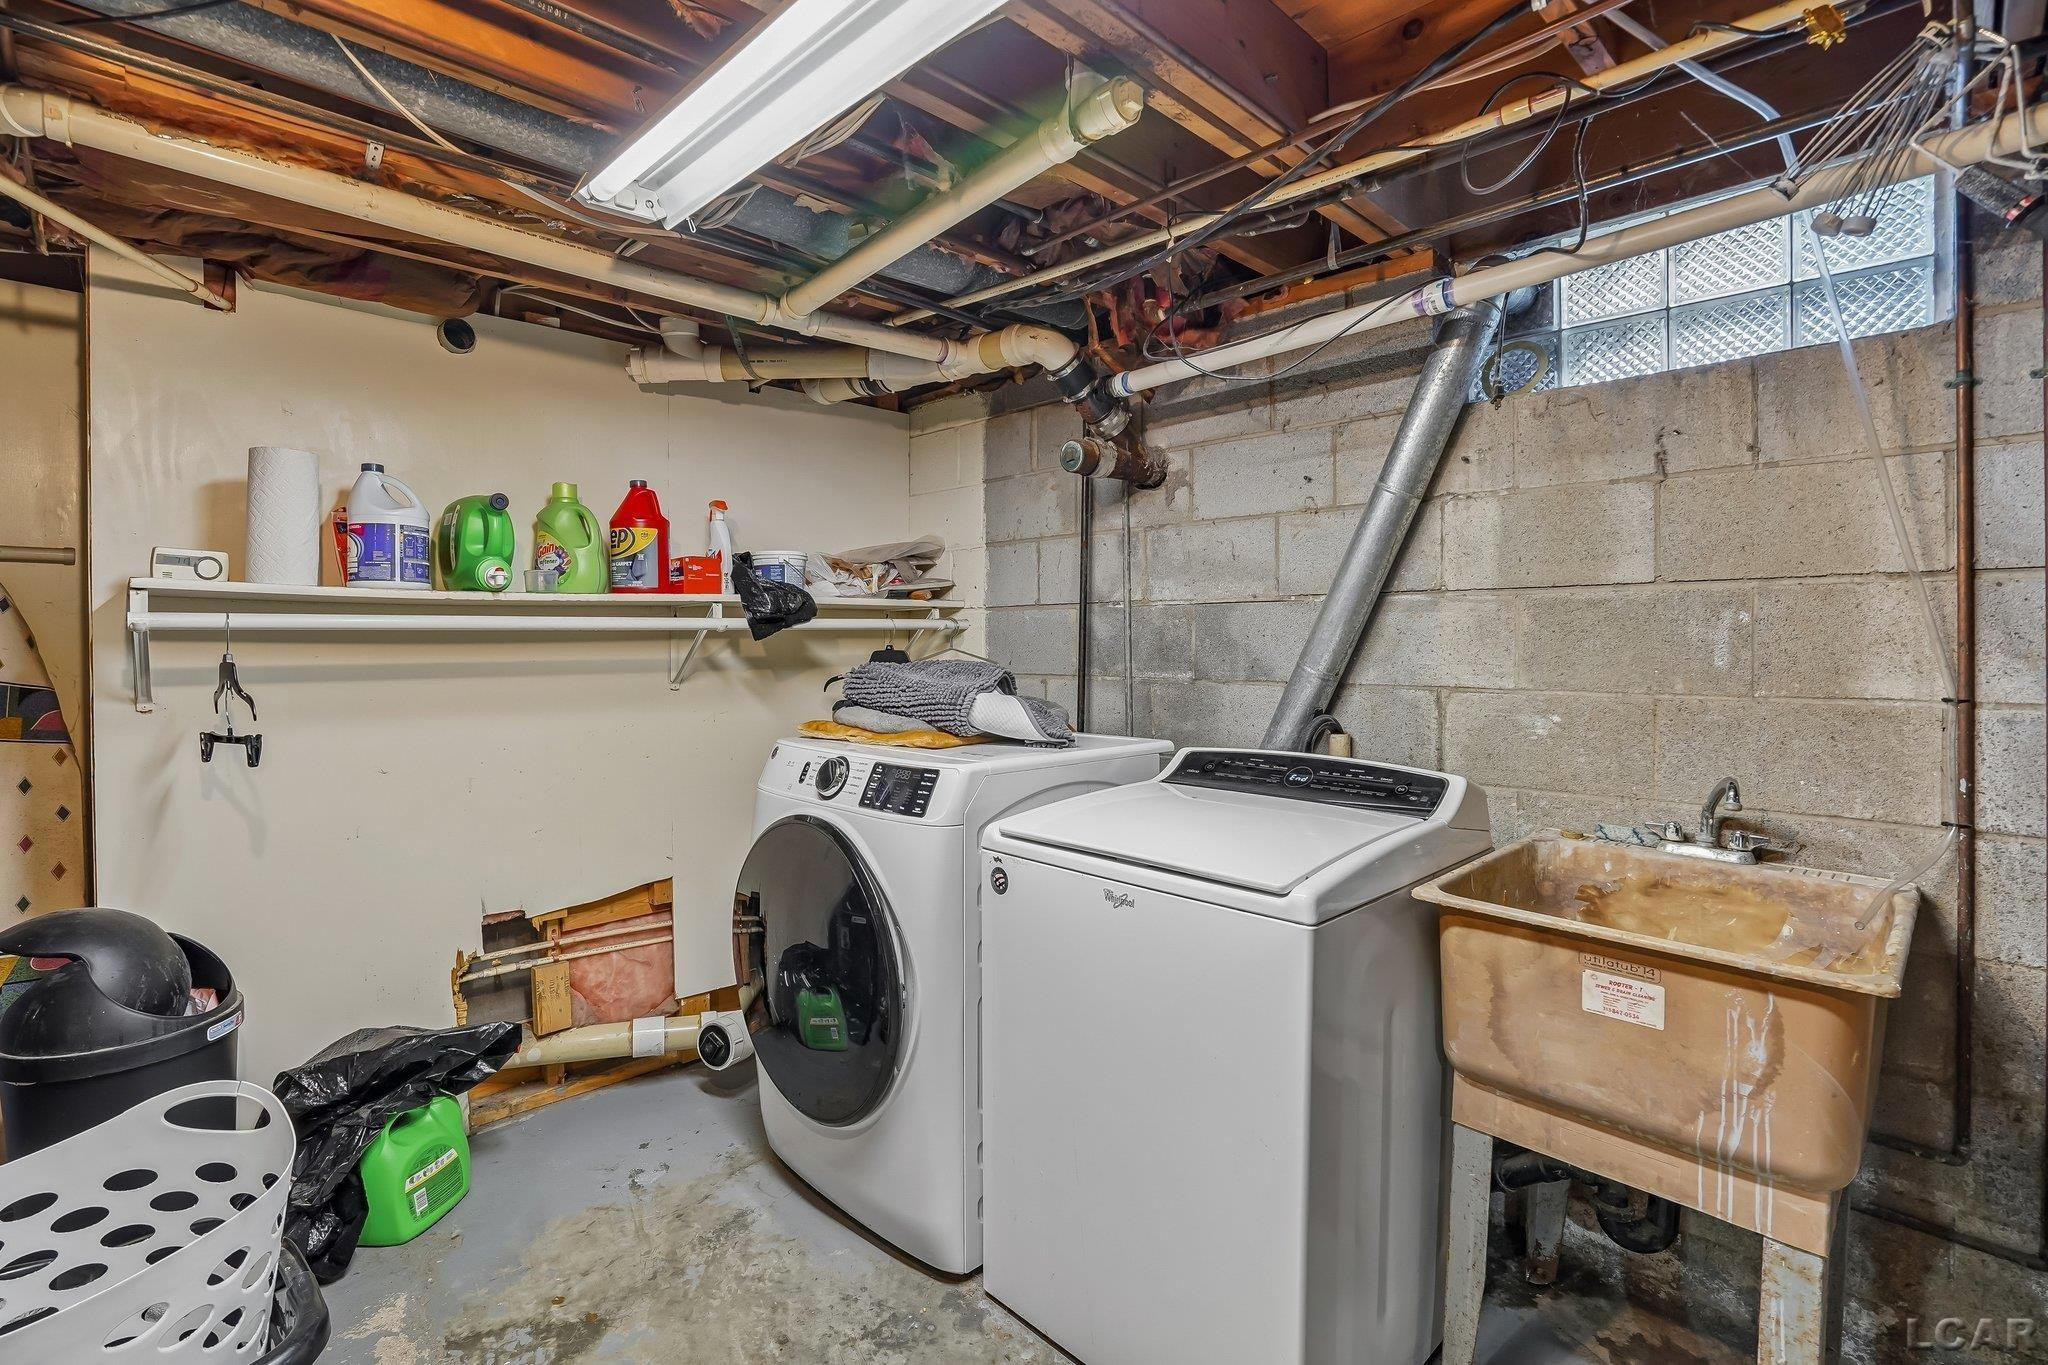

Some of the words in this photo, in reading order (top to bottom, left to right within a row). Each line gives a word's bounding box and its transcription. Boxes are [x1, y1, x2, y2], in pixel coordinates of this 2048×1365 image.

[1289, 774, 1309, 782] End
[1102, 888, 1135, 909] Whirlpool
[1595, 983, 1611, 991] SEWER
[1616, 988, 1632, 996] DRAIN
[1608, 980, 1634, 991] ROOTER
